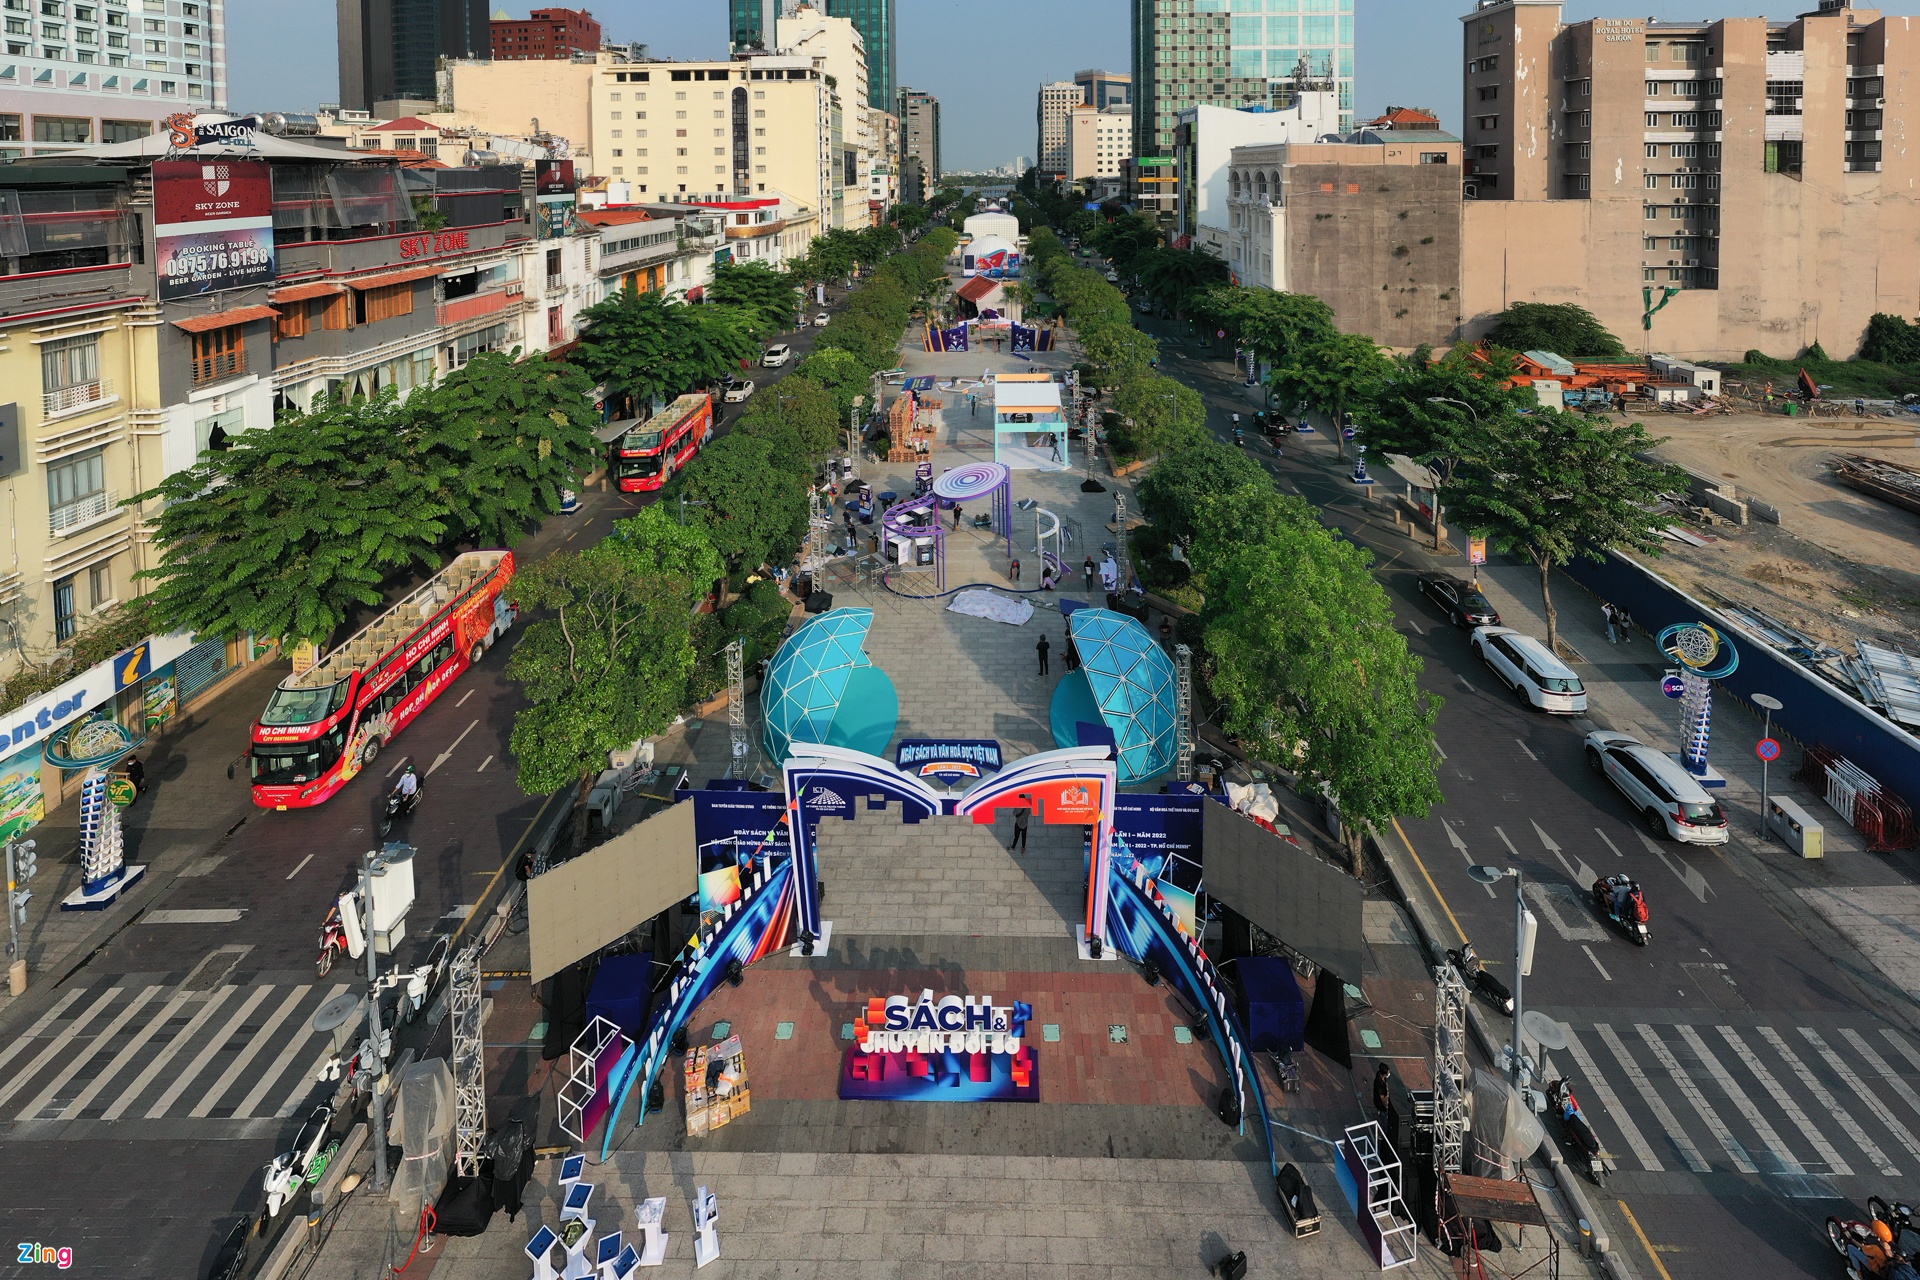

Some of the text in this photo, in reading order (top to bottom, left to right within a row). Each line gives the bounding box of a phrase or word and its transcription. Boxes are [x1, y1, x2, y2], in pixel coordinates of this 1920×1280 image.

[206, 124, 256, 138] SAIGON
[219, 138, 255, 146] CHILL
[182, 240, 254, 255] BOOKING TABLE
[400, 231, 470, 259] SKY ZONE
[166, 248, 268, 277] 0975.76.91.98
[169, 277, 189, 286] BEER
[192, 272, 222, 282] GARDEN
[229, 268, 244, 276] LIVE
[247, 266, 267, 274] MUSIC
[405, 619, 449, 661] HO CHI MINH
[400, 702, 414, 720] HOP
[415, 692, 424, 705] ON
[428, 678, 440, 694] HOP
[272, 727, 287, 735] CHI
[287, 726, 310, 734] MINH
[900, 744, 999, 766] NGÀY SÁCH VÀ VĂN HOÁ ĐỌC VIỆT NAM
[884, 998, 1006, 1031] SÁCH &
